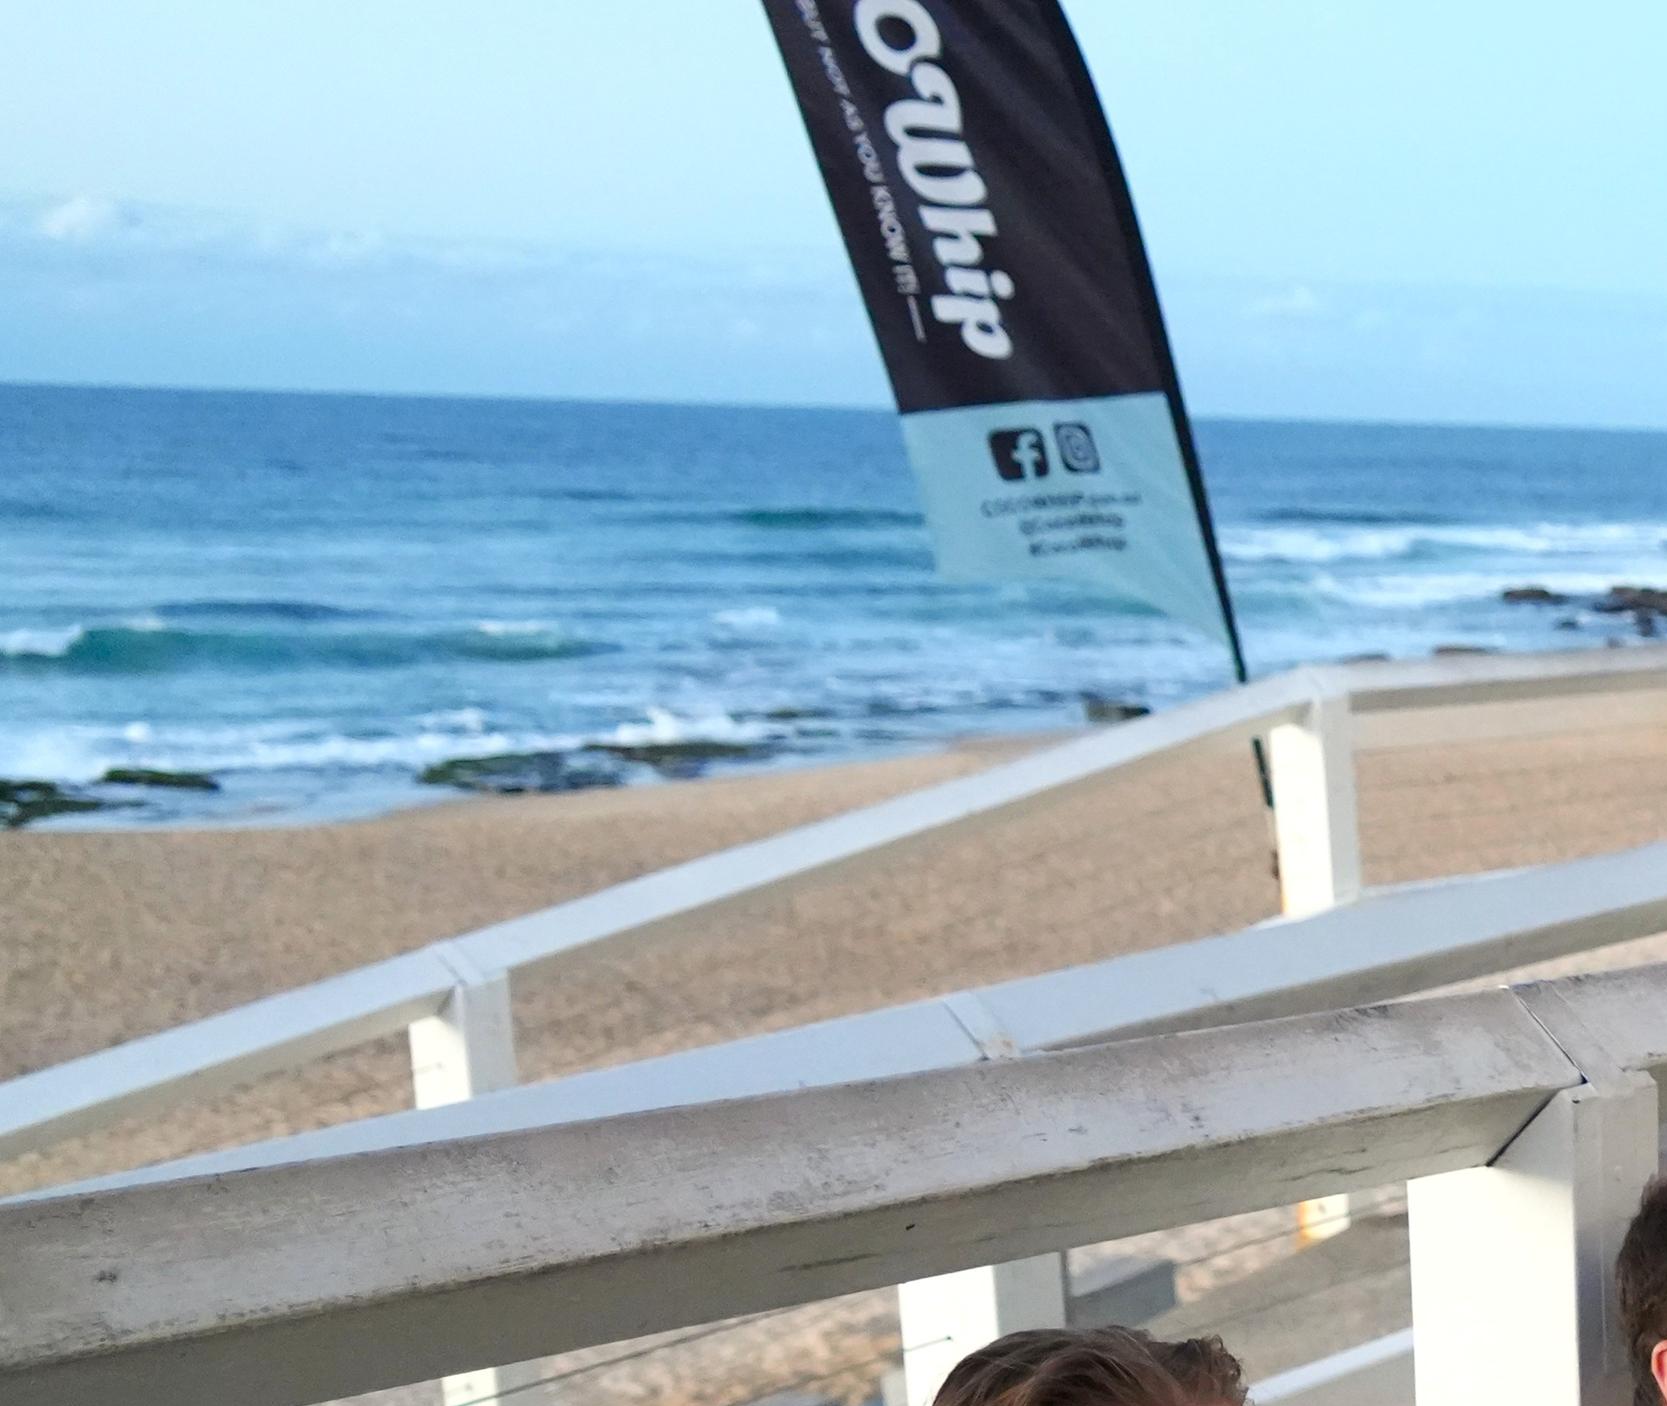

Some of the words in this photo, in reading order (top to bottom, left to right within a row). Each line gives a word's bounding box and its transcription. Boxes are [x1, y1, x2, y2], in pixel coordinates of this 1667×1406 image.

[818, 46, 850, 97] NOT
[854, 131, 885, 184] YOU
[870, 185, 911, 263] KNOW
